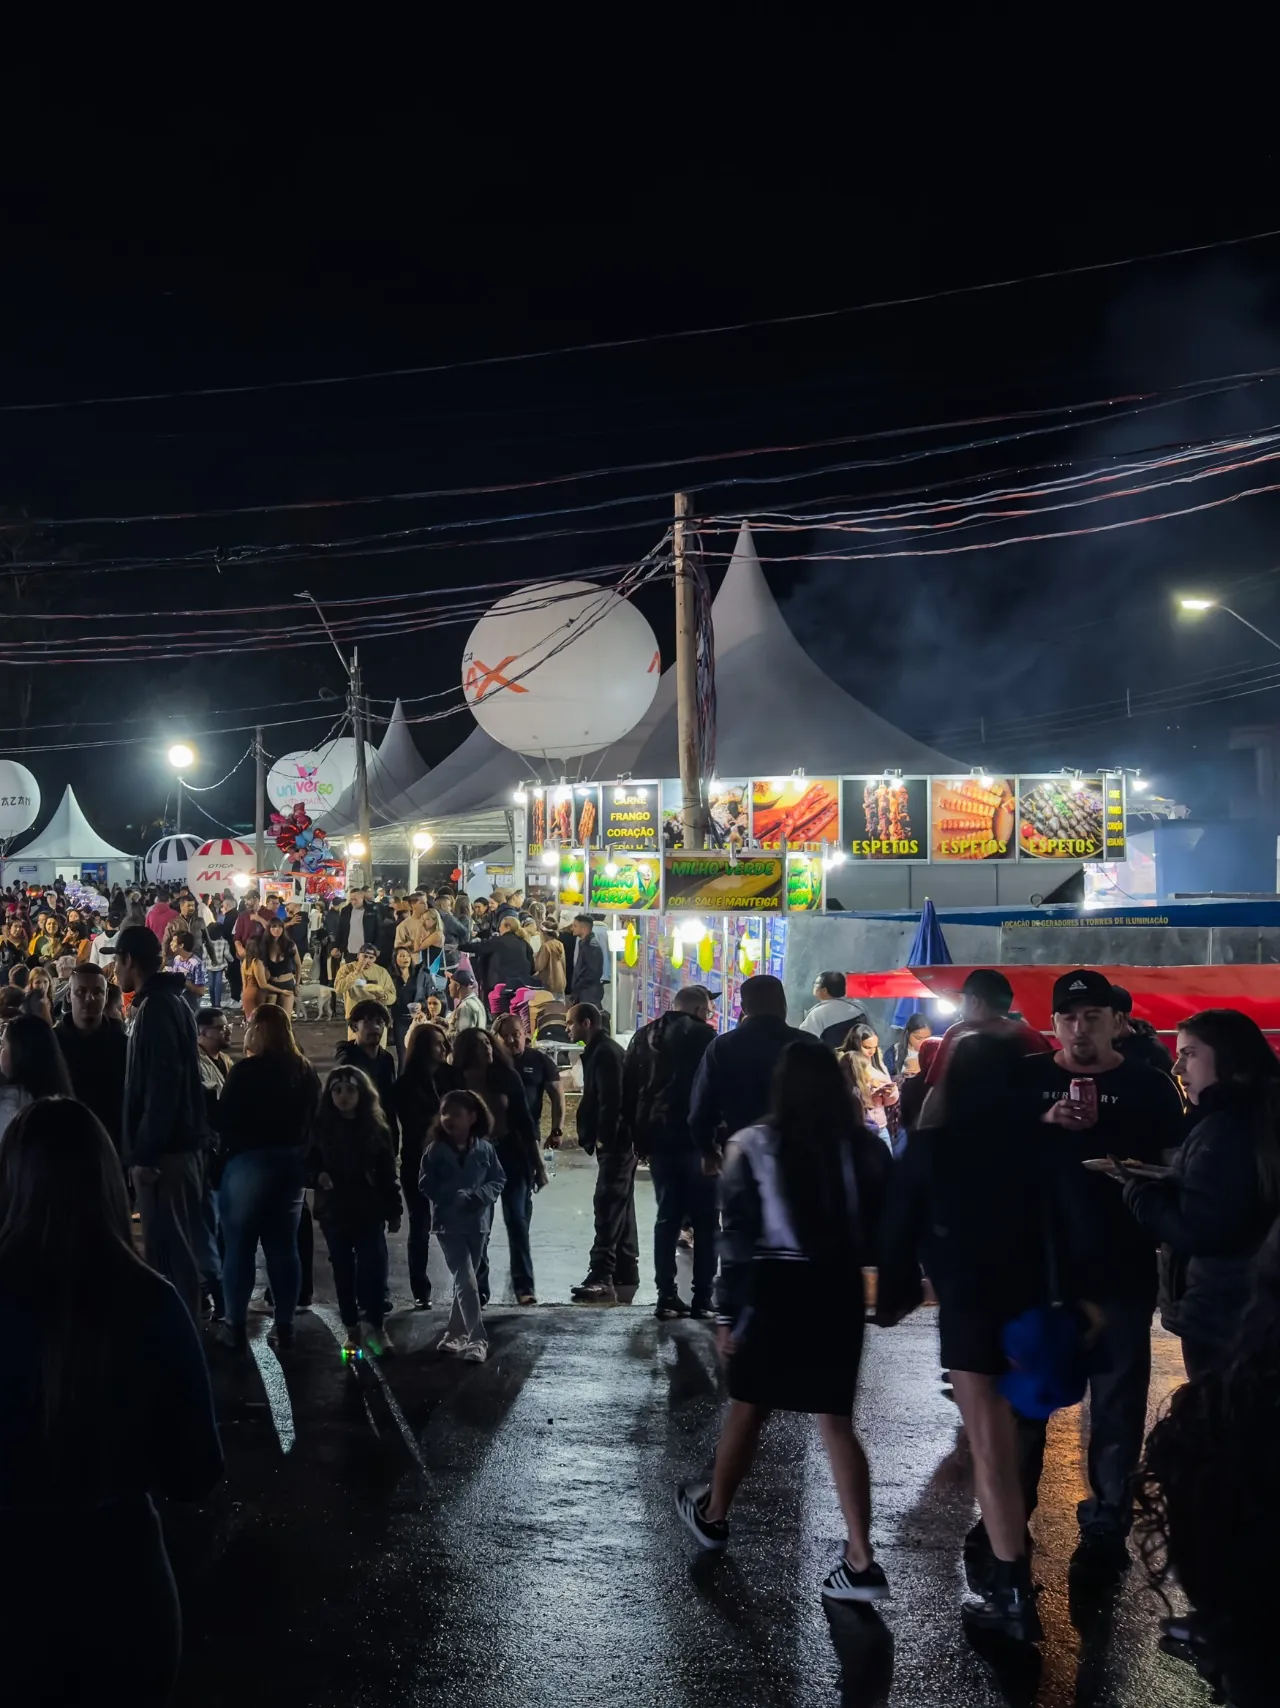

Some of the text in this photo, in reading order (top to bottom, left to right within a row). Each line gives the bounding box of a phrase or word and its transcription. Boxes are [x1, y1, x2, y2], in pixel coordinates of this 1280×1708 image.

[613, 796, 647, 805] CARNE
[610, 812, 650, 821] FRANGO
[607, 826, 655, 838] CORAÇÃO
[852, 840, 918, 854] ESPETOS
[941, 839, 1007, 854] ESPETOS
[1029, 839, 1095, 853] ESPETOS
[671, 861, 776, 875] MILHO VERDE
[593, 874, 634, 888] MILHO
[591, 889, 636, 904] VERDE
[668, 897, 691, 906] COM
[695, 897, 712, 906] SAL
[715, 897, 722, 906] E
[725, 897, 779, 907] MANTEIGA
[1042, 919, 1078, 927] GERADORES
[1086, 917, 1113, 926] TORRES
[1114, 917, 1124, 925] DE
[1042, 1091, 1119, 1104] BURRY
